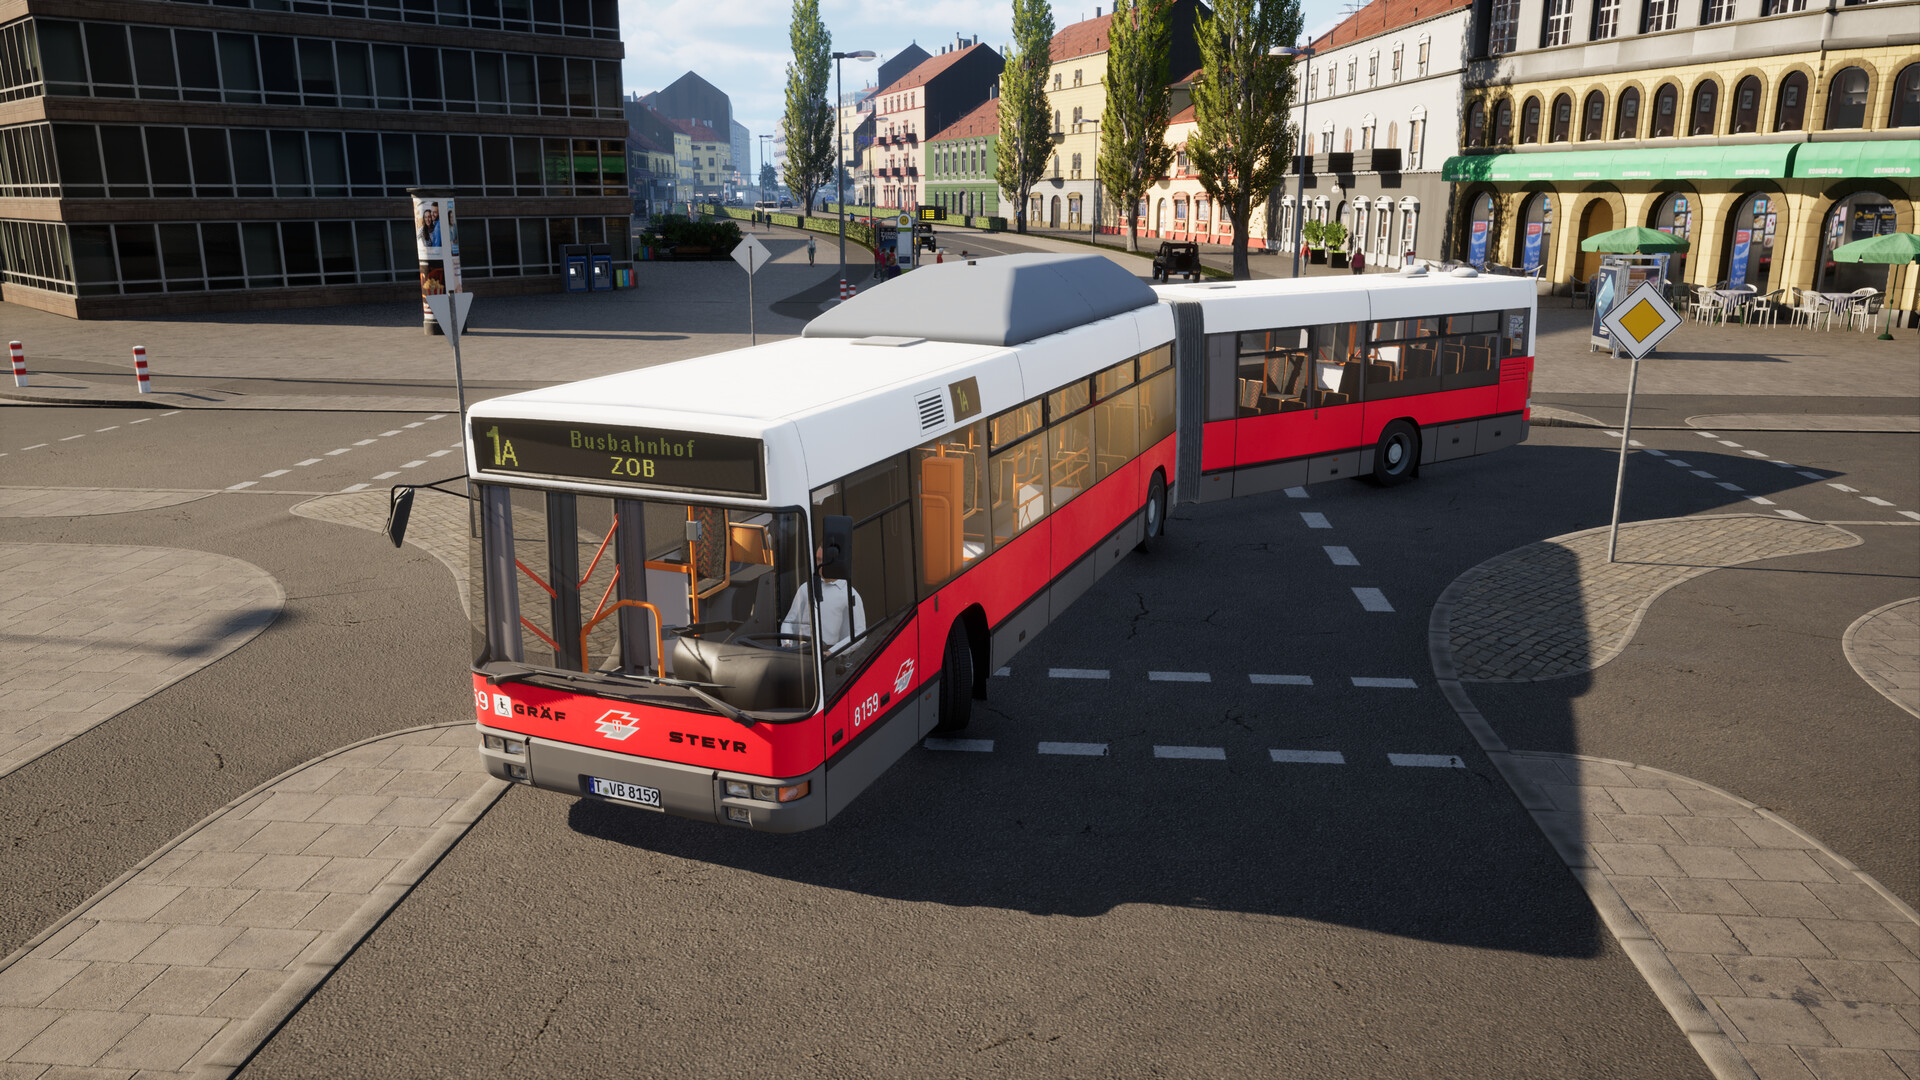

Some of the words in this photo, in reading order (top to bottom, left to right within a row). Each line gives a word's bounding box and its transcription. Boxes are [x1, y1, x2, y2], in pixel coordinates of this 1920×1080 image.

[956, 386, 969, 413] 1A
[486, 425, 519, 467] 1A
[570, 430, 695, 458] Busbahnhof
[610, 456, 655, 478] ZOB
[854, 692, 879, 727] 8159
[513, 703, 566, 721] GRÄF
[669, 731, 747, 754] STEYR
[594, 779, 602, 793] T
[609, 782, 625, 797] VB
[628, 786, 659, 803] 8159
